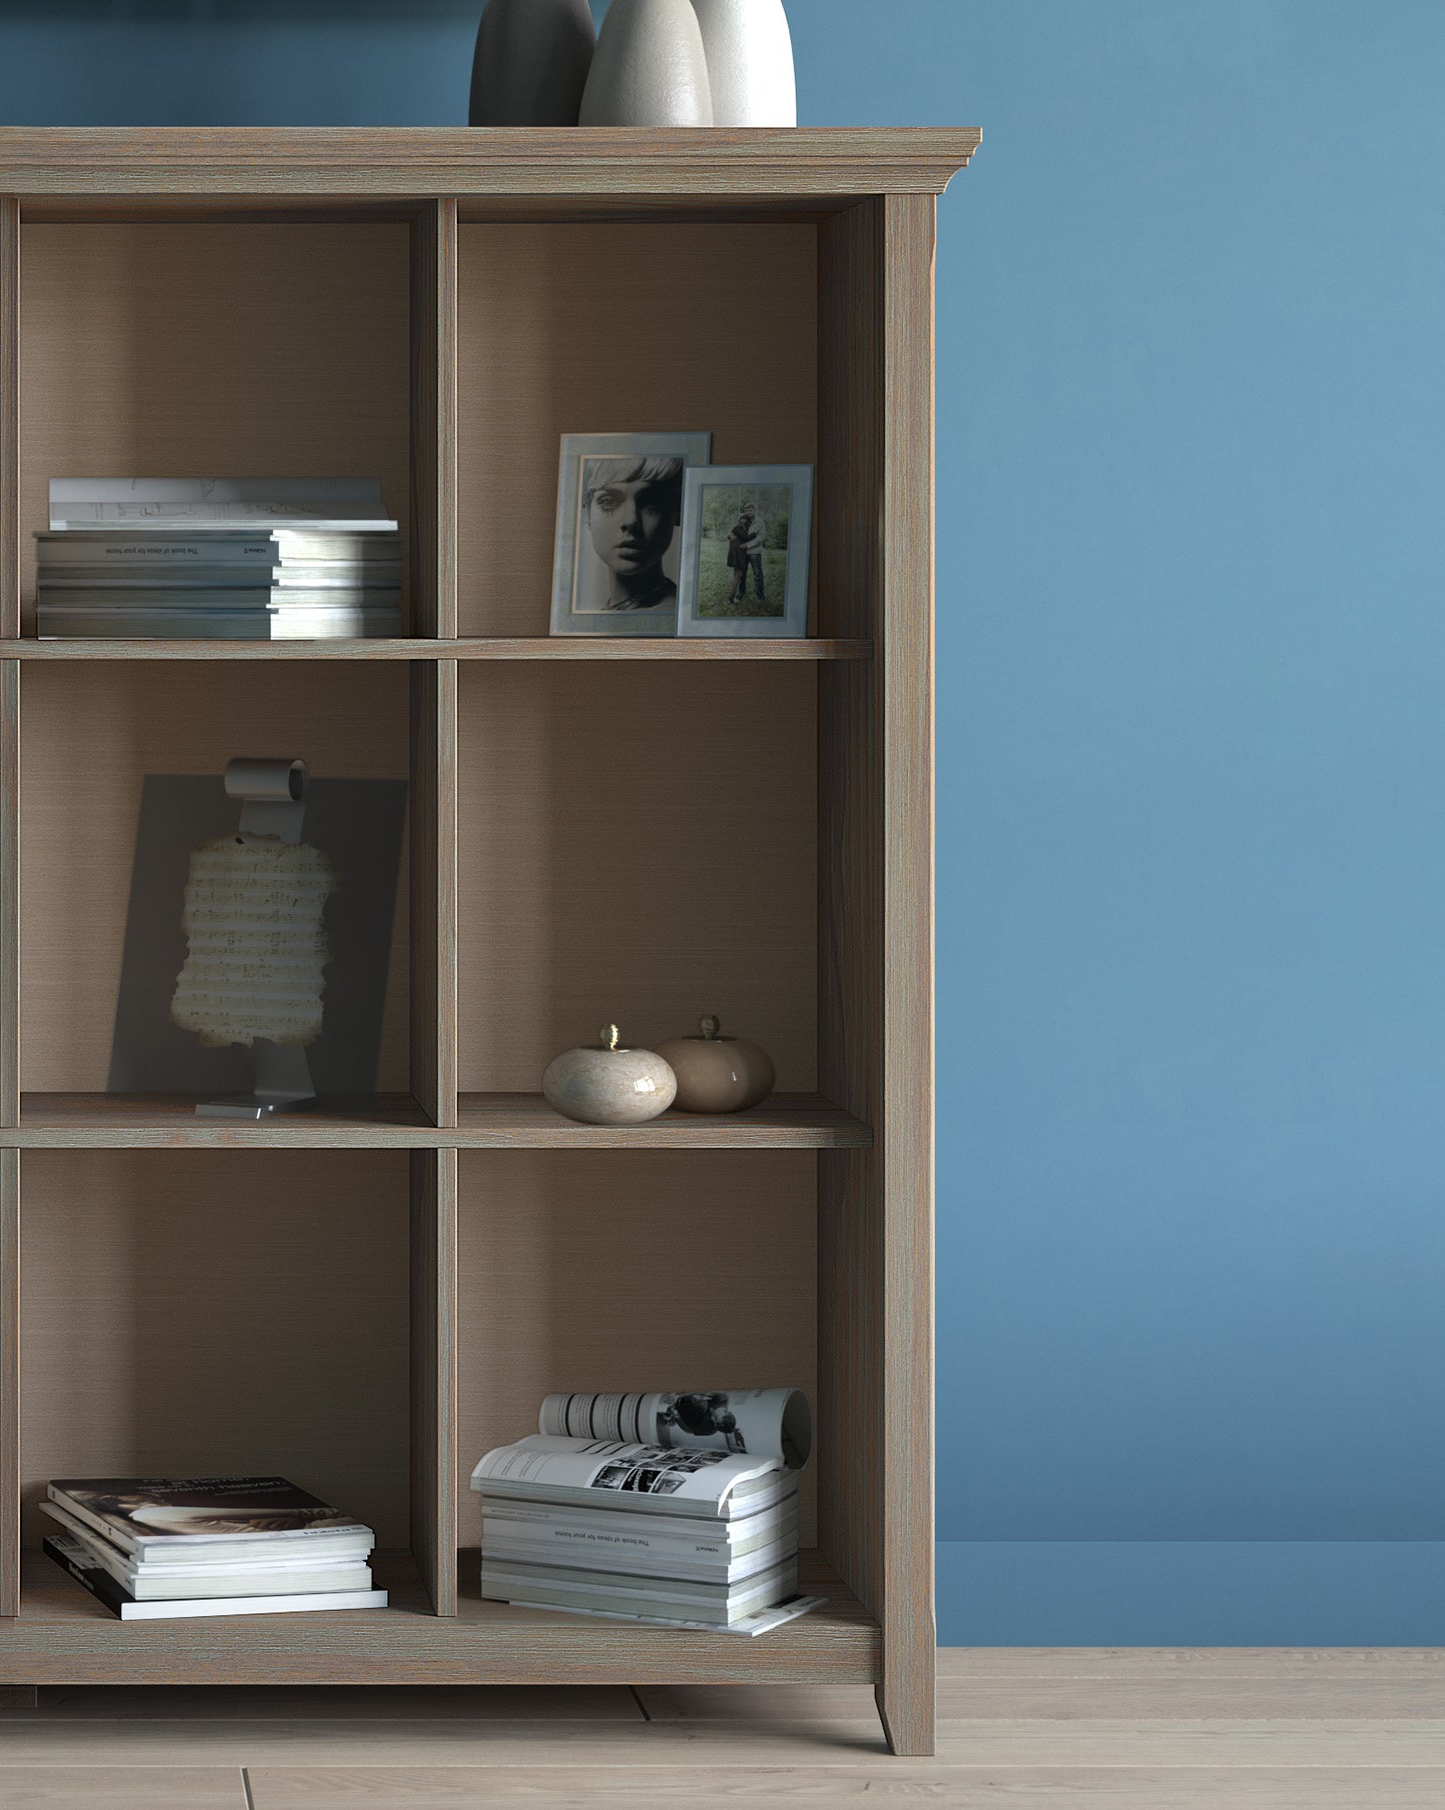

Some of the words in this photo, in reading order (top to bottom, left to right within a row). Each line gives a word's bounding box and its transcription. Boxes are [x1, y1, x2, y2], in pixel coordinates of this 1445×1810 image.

[555, 1531, 572, 1539] home
[597, 1535, 613, 1543] ideas
[622, 1538, 637, 1546] book
